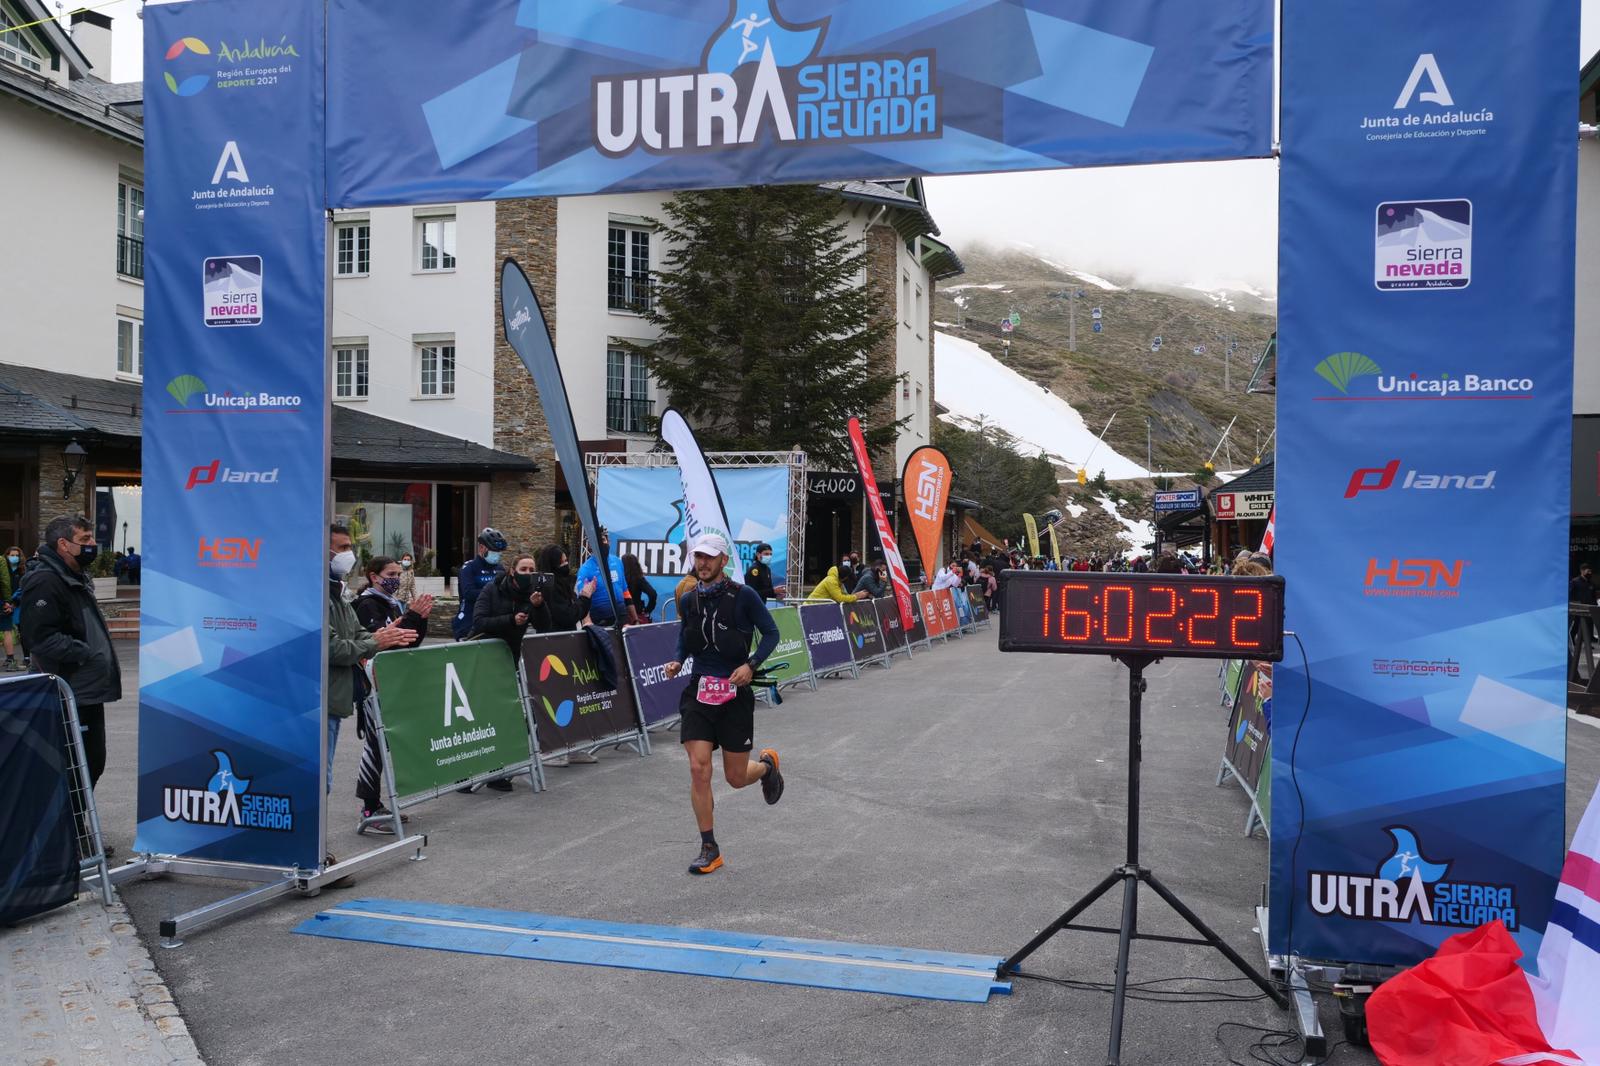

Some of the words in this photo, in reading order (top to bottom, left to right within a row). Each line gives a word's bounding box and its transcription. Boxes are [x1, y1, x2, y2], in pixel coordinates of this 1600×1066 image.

[217, 35, 299, 63] Andalucía
[217, 69, 243, 79] Región
[245, 67, 277, 76] Europea
[279, 65, 291, 73] del
[217, 78, 255, 88] DEPORTE
[257, 77, 277, 86] 2021
[797, 56, 929, 101] SIERRA
[597, 36, 796, 152] ULTRA
[798, 95, 935, 139] NEVADA
[1360, 116, 1399, 128] Junta
[1403, 114, 1420, 126] de
[1423, 108, 1493, 125] Andalucía
[1366, 132, 1402, 141] Consejería
[1403, 131, 1413, 139] de
[1414, 129, 1449, 138] Educación
[1457, 128, 1486, 137] Deporte
[192, 190, 215, 199] Junta
[217, 188, 228, 198] de
[230, 185, 274, 197] Andalucía
[1407, 245, 1462, 261] sierra
[1386, 261, 1462, 276] nevada
[223, 291, 257, 303] sierra
[211, 304, 257, 316] nevada
[1378, 372, 1460, 396] Unicaja
[1465, 375, 1533, 391] Banco
[205, 391, 257, 409] Unicaja
[259, 393, 301, 406] Banco
[914, 461, 939, 520] HSN
[1245, 494, 1274, 502] WHITE
[198, 536, 261, 561] HSN
[1364, 558, 1463, 588] HSN
[1043, 585, 1262, 646] 16:02:22
[430, 736, 452, 752] Junta
[453, 732, 462, 746] de
[463, 722, 496, 743] Andalucía
[165, 781, 241, 825] ULTRA
[242, 794, 289, 813] SIERRA
[242, 810, 292, 830] NEVADA
[1311, 865, 1433, 922] ULTRA
[1434, 884, 1511, 907] SIERRA
[1433, 903, 1515, 928] NEVADA
